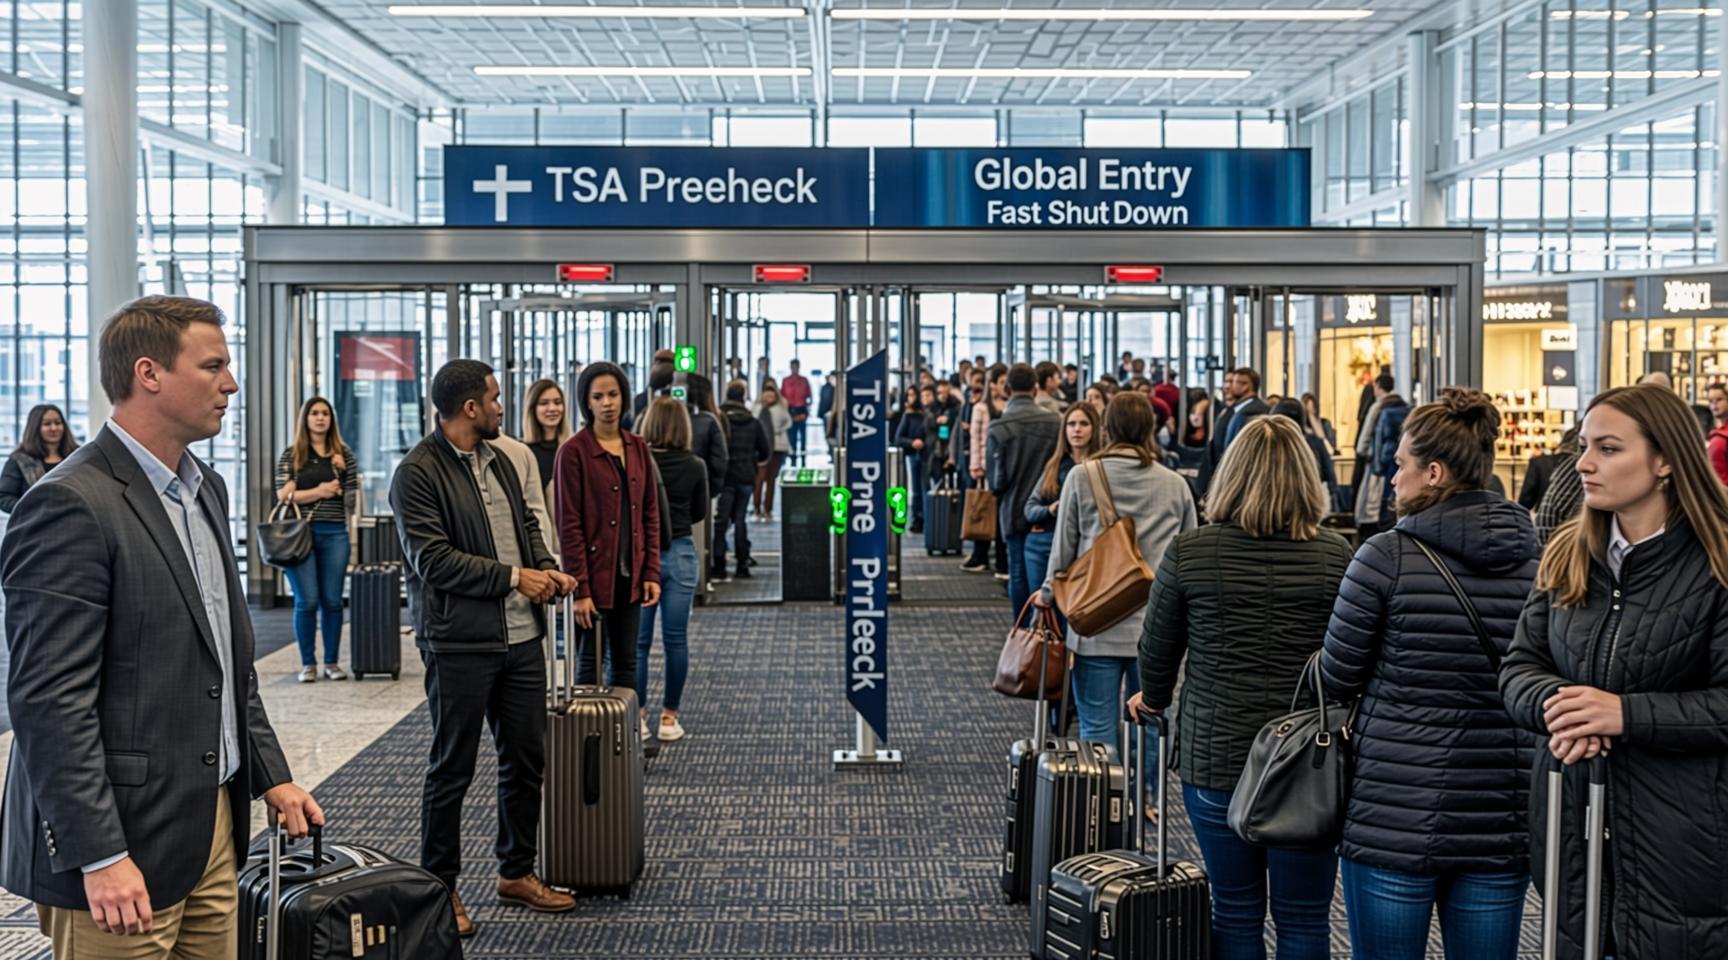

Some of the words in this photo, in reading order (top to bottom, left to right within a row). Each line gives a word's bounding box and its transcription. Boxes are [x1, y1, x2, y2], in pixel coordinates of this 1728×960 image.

[546, 167, 628, 203] TSA
[640, 167, 817, 203] Preeheck
[975, 157, 1087, 190] Global
[1099, 159, 1192, 198] Entry
[987, 200, 1042, 225] Fast
[1048, 200, 1110, 225] Shut
[1114, 200, 1188, 225] Down
[851, 380, 881, 439] TSA
[851, 462, 881, 533] Prre
